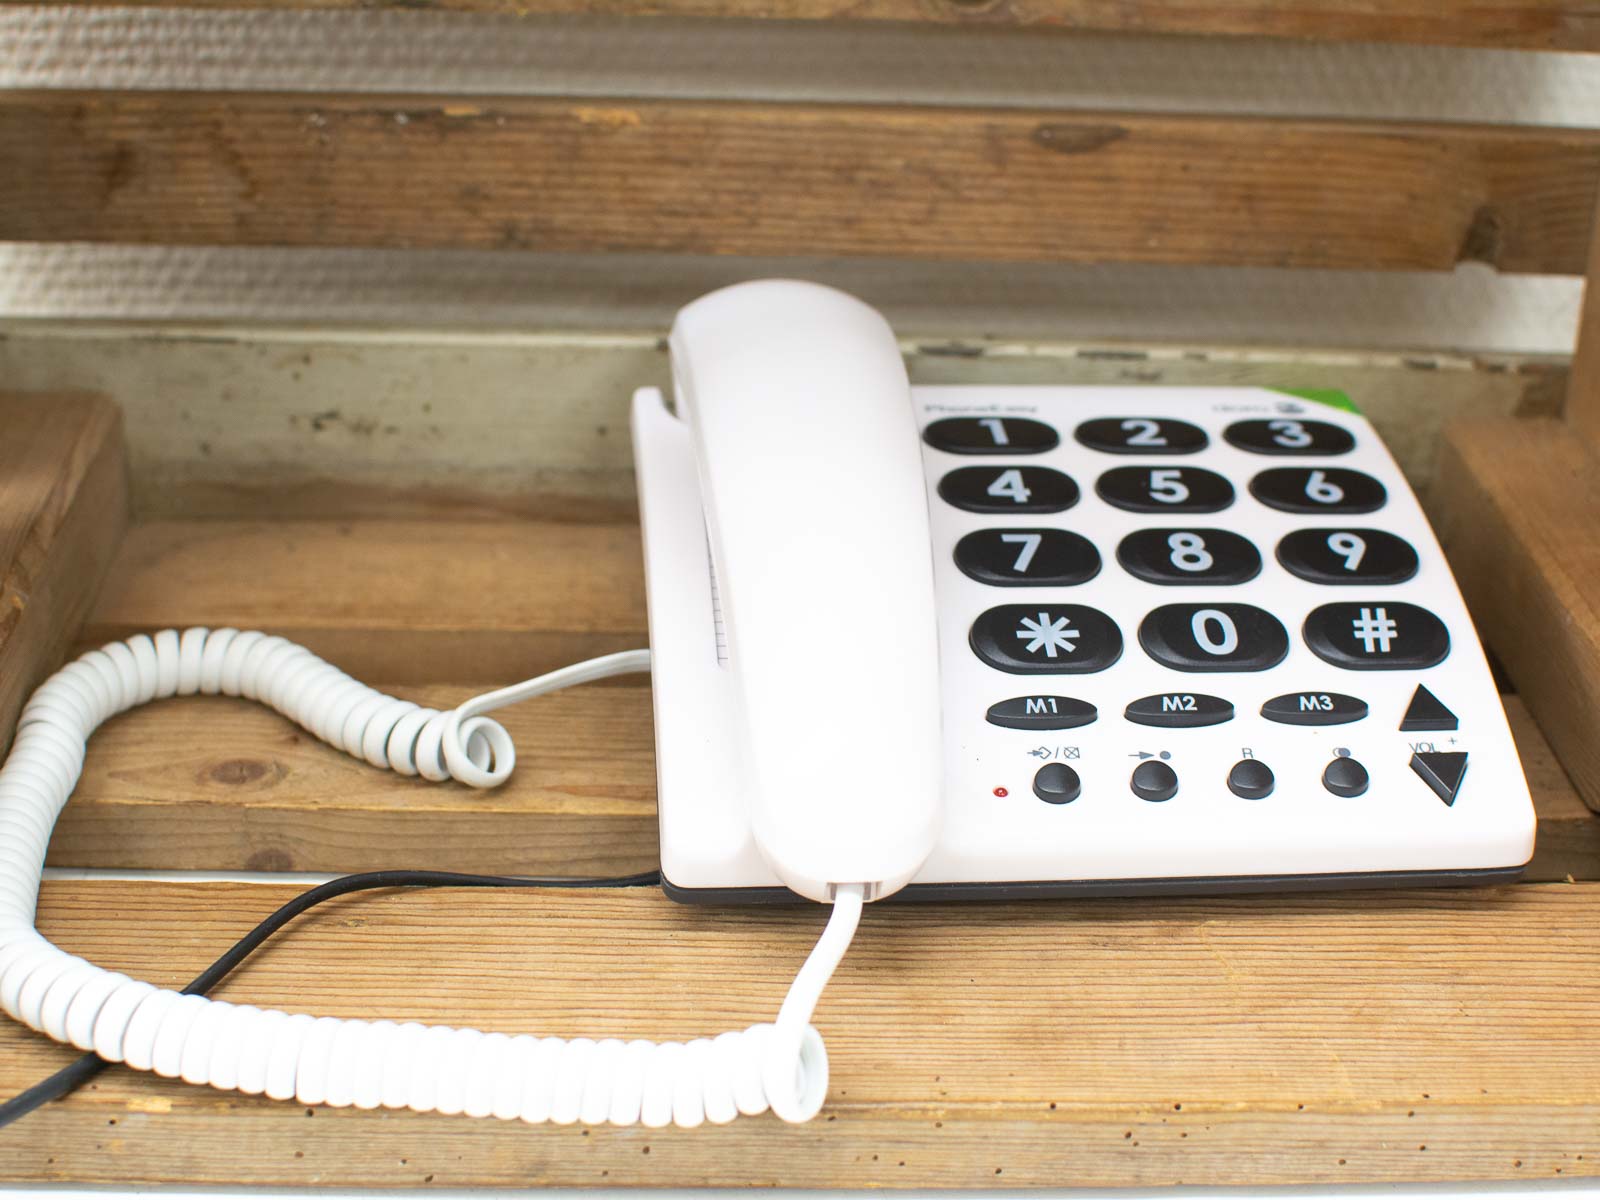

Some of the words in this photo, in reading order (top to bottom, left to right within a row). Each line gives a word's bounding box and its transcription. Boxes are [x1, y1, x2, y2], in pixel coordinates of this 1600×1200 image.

[978, 419, 1009, 445] 1
[1121, 419, 1168, 446] 2
[1267, 420, 1313, 448] 3
[987, 469, 1031, 503] 4
[1150, 470, 1190, 503] 5
[1305, 471, 1345, 504] 6
[1000, 534, 1042, 573] 7
[1168, 532, 1214, 572] 8
[1327, 532, 1366, 572] 9
[1191, 609, 1239, 656] 0
[1352, 607, 1398, 653] #
[1025, 697, 1058, 714] M1
[1162, 695, 1198, 712] M2
[1299, 694, 1334, 711] M3
[1241, 747, 1253, 758] R
